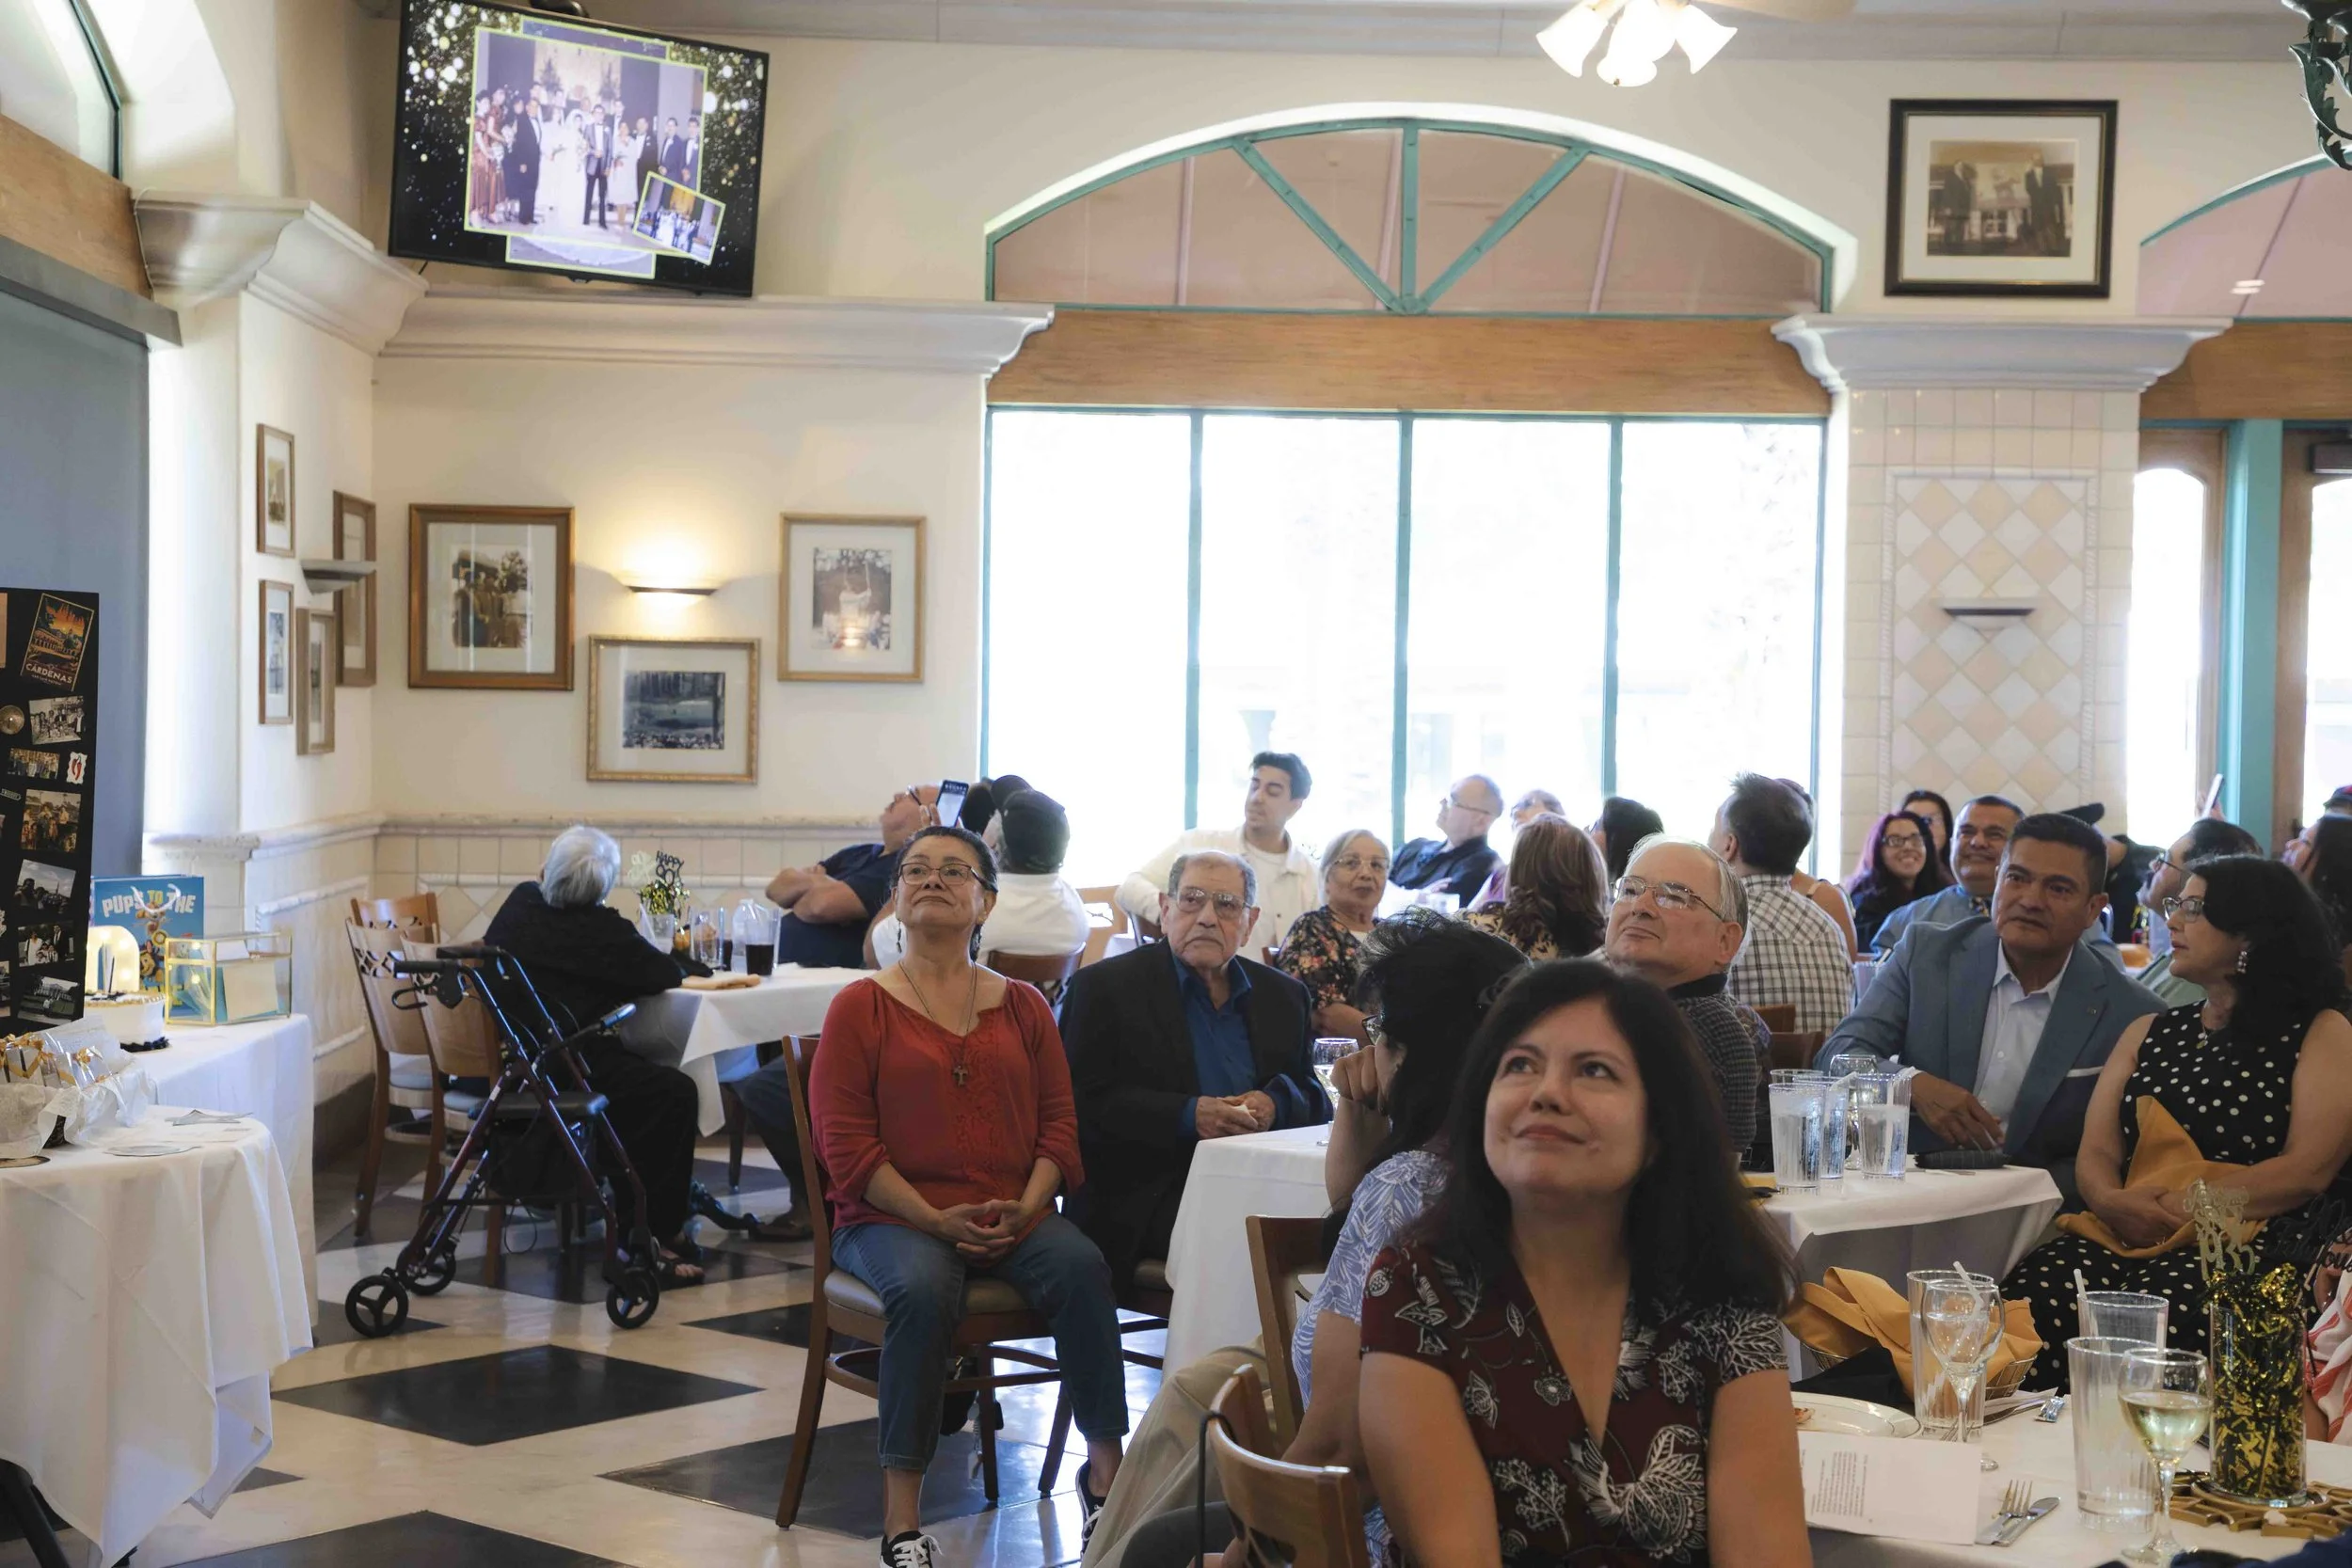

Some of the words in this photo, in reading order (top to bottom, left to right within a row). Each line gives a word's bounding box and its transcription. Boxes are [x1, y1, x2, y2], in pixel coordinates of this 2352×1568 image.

[102, 891, 143, 918] PUPS
[147, 889, 163, 905] TO
[167, 892, 196, 913] THE
